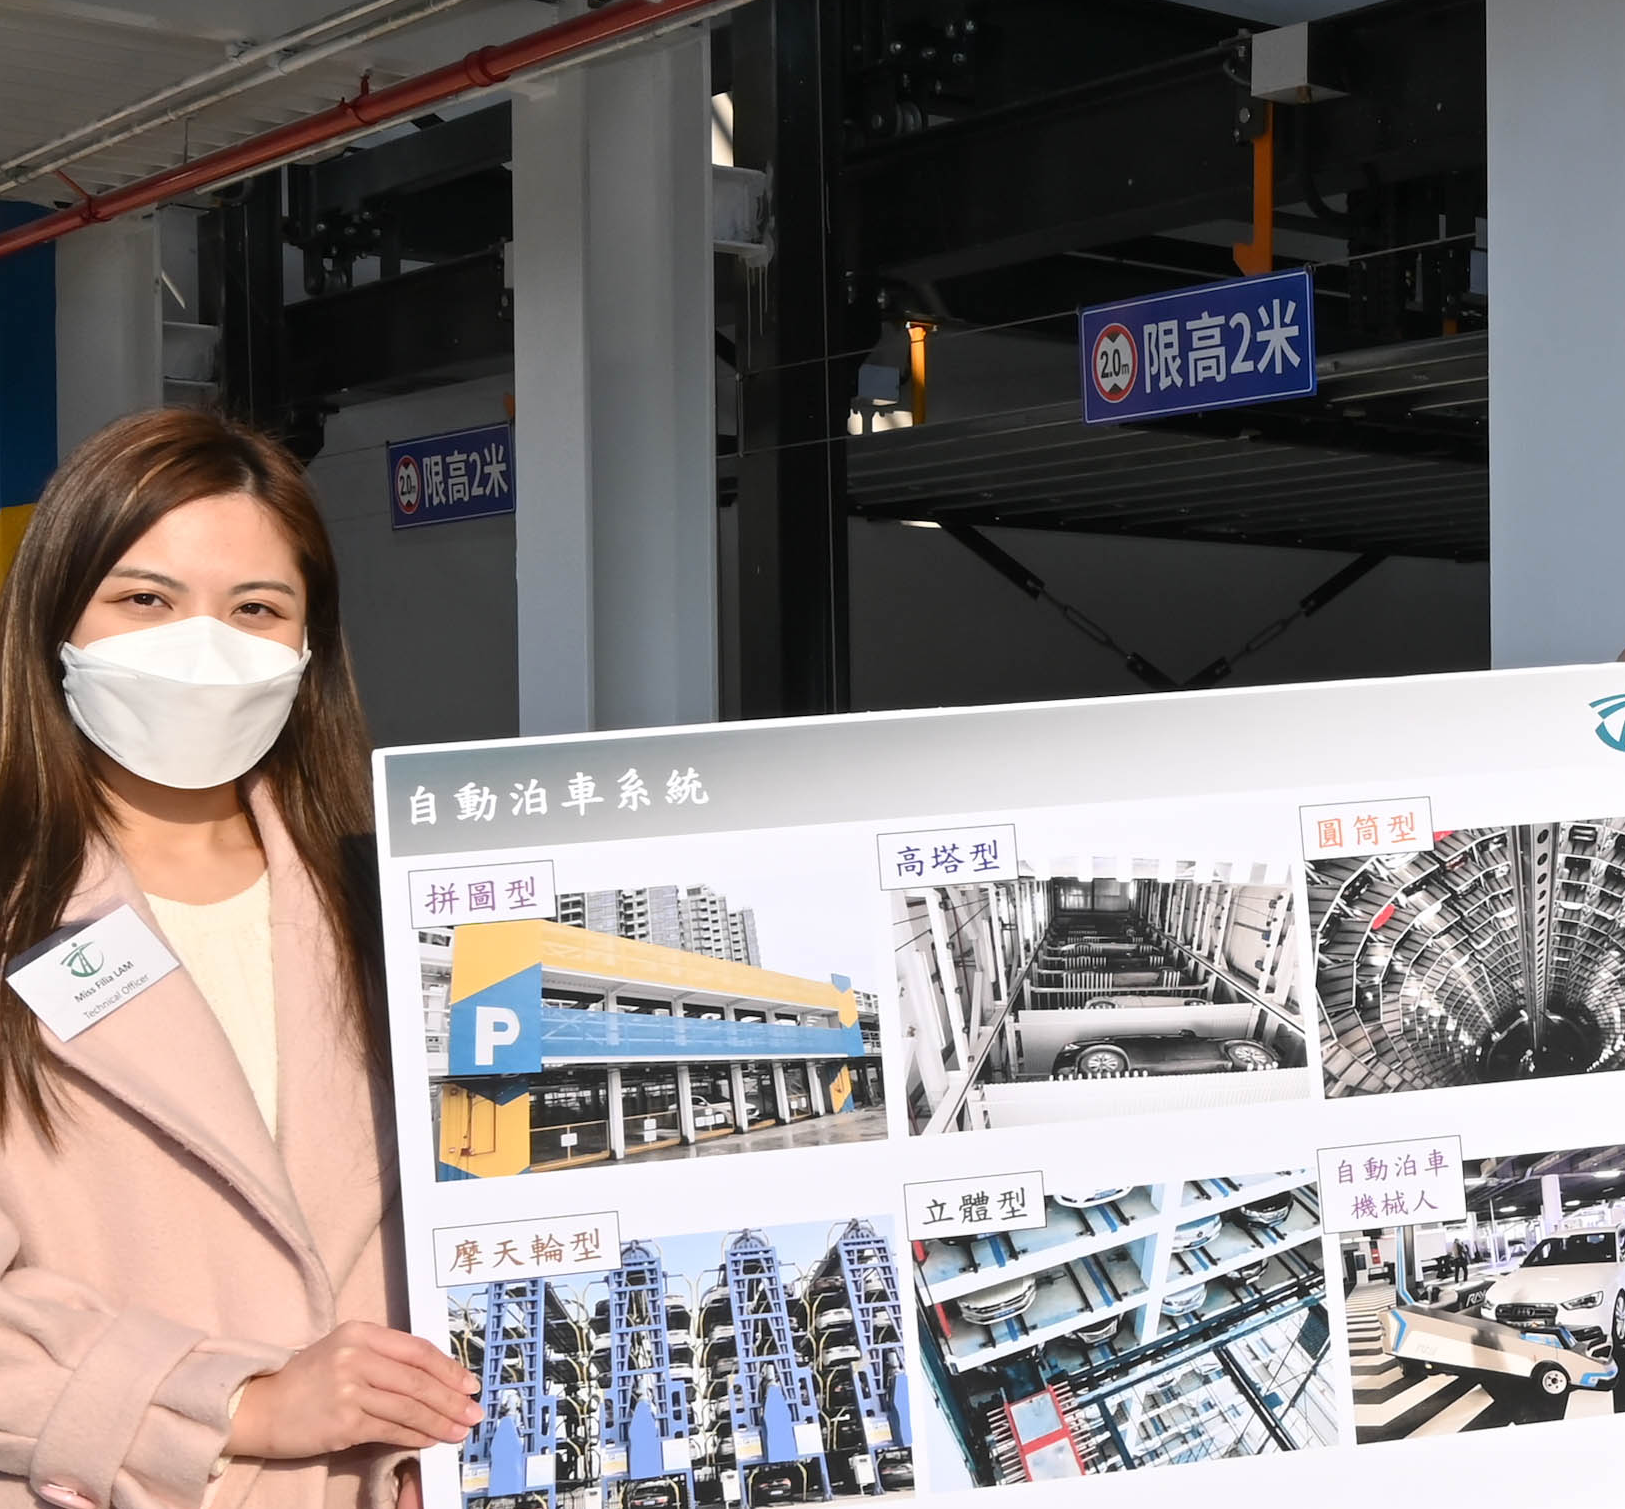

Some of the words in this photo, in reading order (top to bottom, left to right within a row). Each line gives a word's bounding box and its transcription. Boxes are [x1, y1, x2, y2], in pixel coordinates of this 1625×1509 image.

[1100, 349, 1129, 379] 2.0m
[1143, 299, 1301, 394] 限高2米
[422, 443, 508, 508] 限高2米
[409, 767, 710, 825] 自動泊車系統
[1317, 812, 1417, 849] 圓筒型
[896, 839, 1000, 877] 高塔型
[425, 876, 537, 915] 拼圖型
[74, 987, 96, 1003] Miss
[113, 960, 134, 977] LAM
[83, 991, 121, 1019] Technical
[121, 974, 149, 995] Officer
[475, 1006, 521, 1066] P
[1338, 1149, 1449, 1184] 自動泊車
[922, 1187, 1028, 1225] 立體型
[1351, 1190, 1439, 1220] 機械人
[449, 1228, 602, 1275] 摩天輪型
